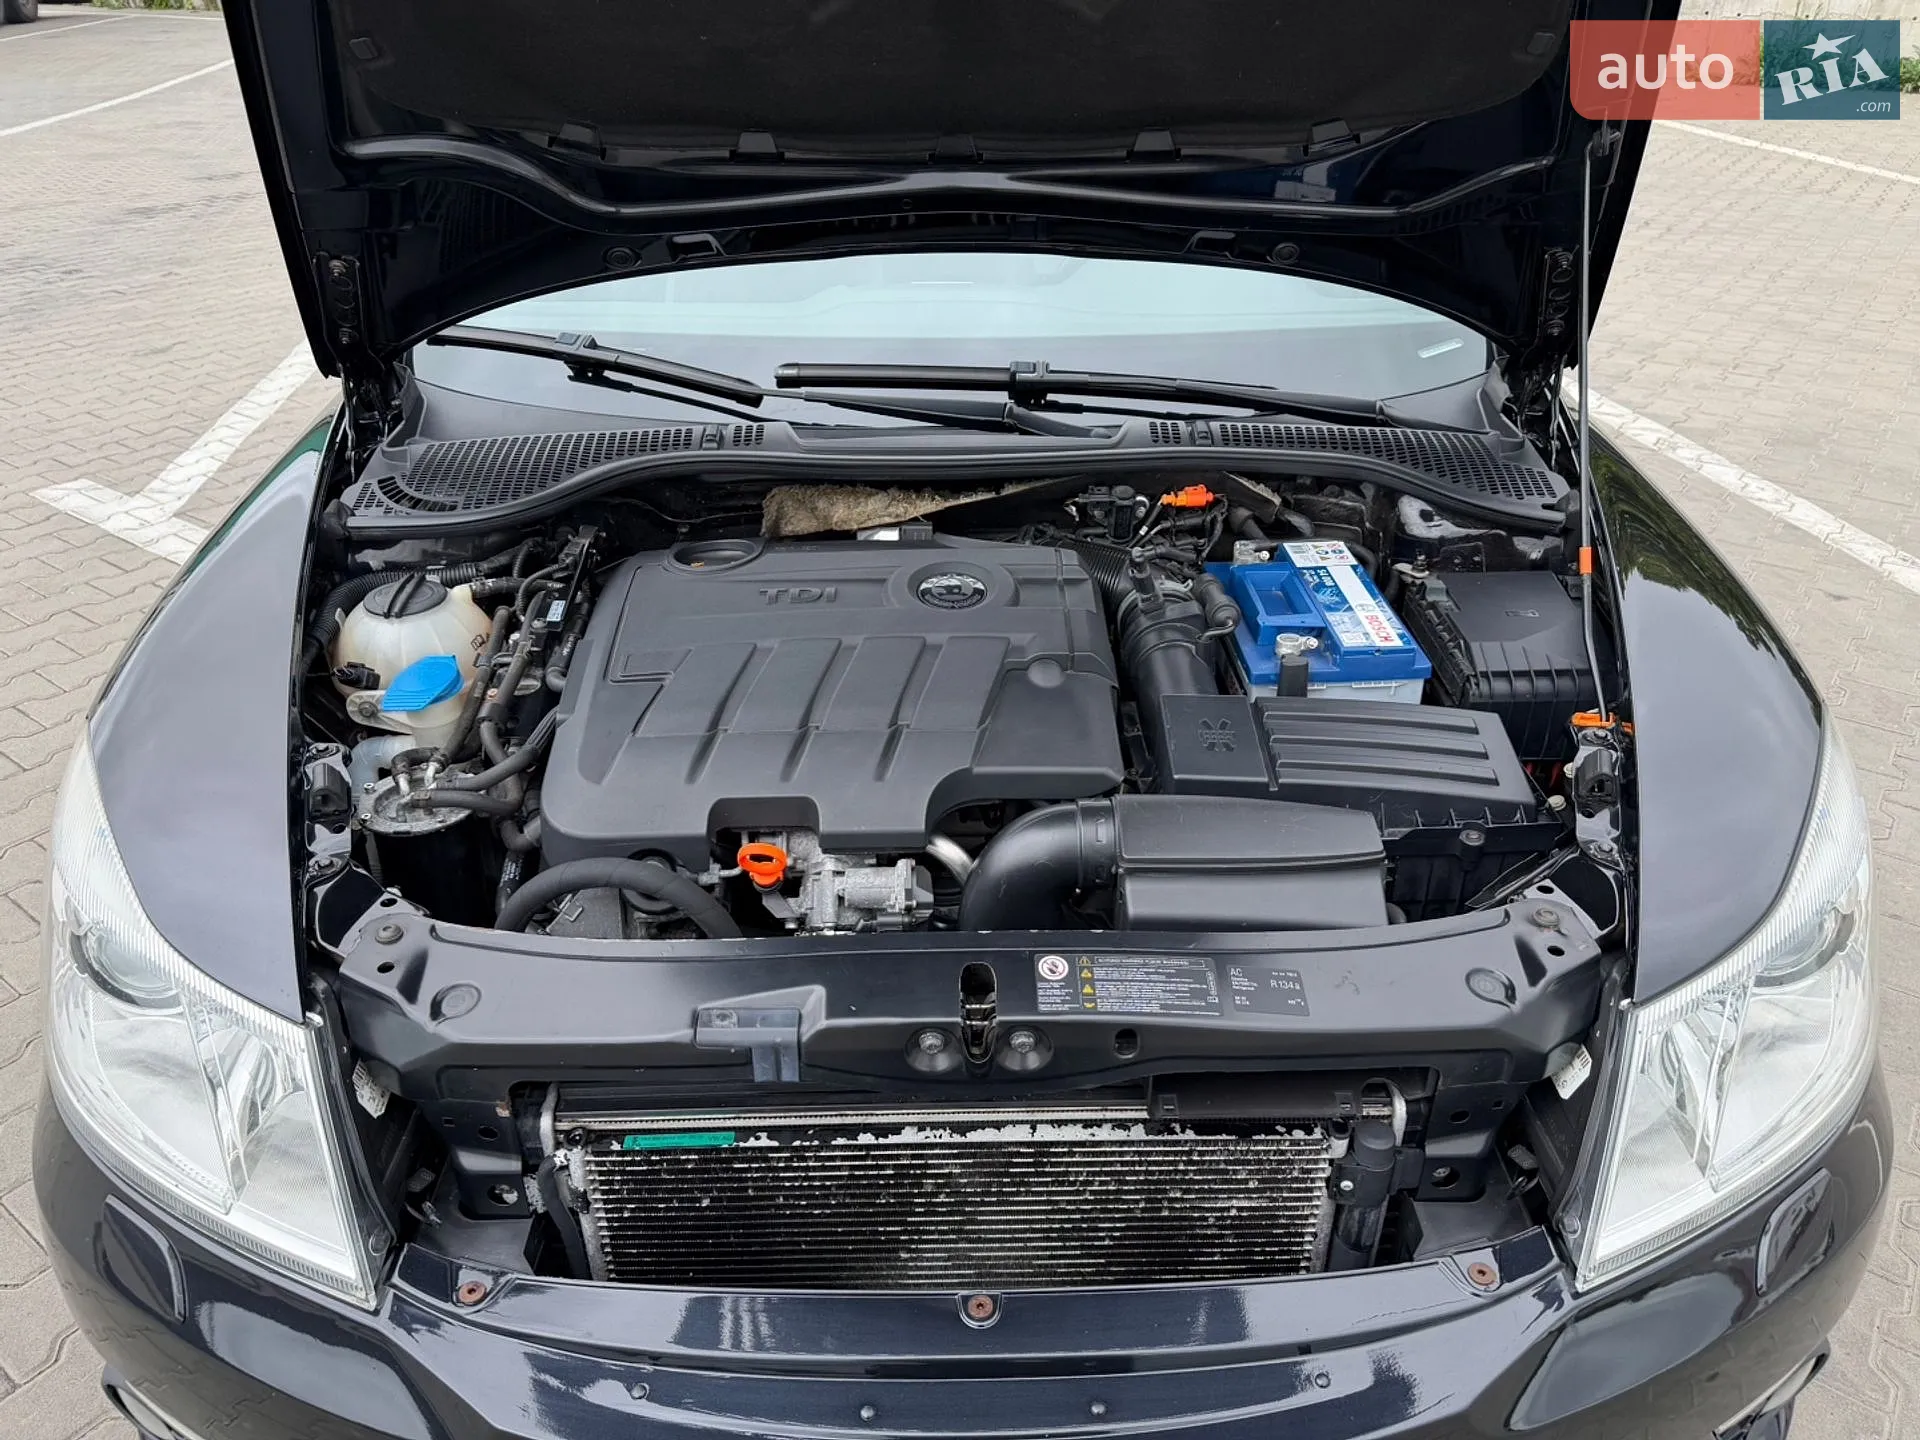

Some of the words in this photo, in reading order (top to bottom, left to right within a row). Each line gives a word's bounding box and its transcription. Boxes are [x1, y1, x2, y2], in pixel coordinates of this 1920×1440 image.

[759, 586, 838, 605] TDI
[1363, 614, 1395, 643] BOSCH
[1230, 967, 1243, 977] AC
